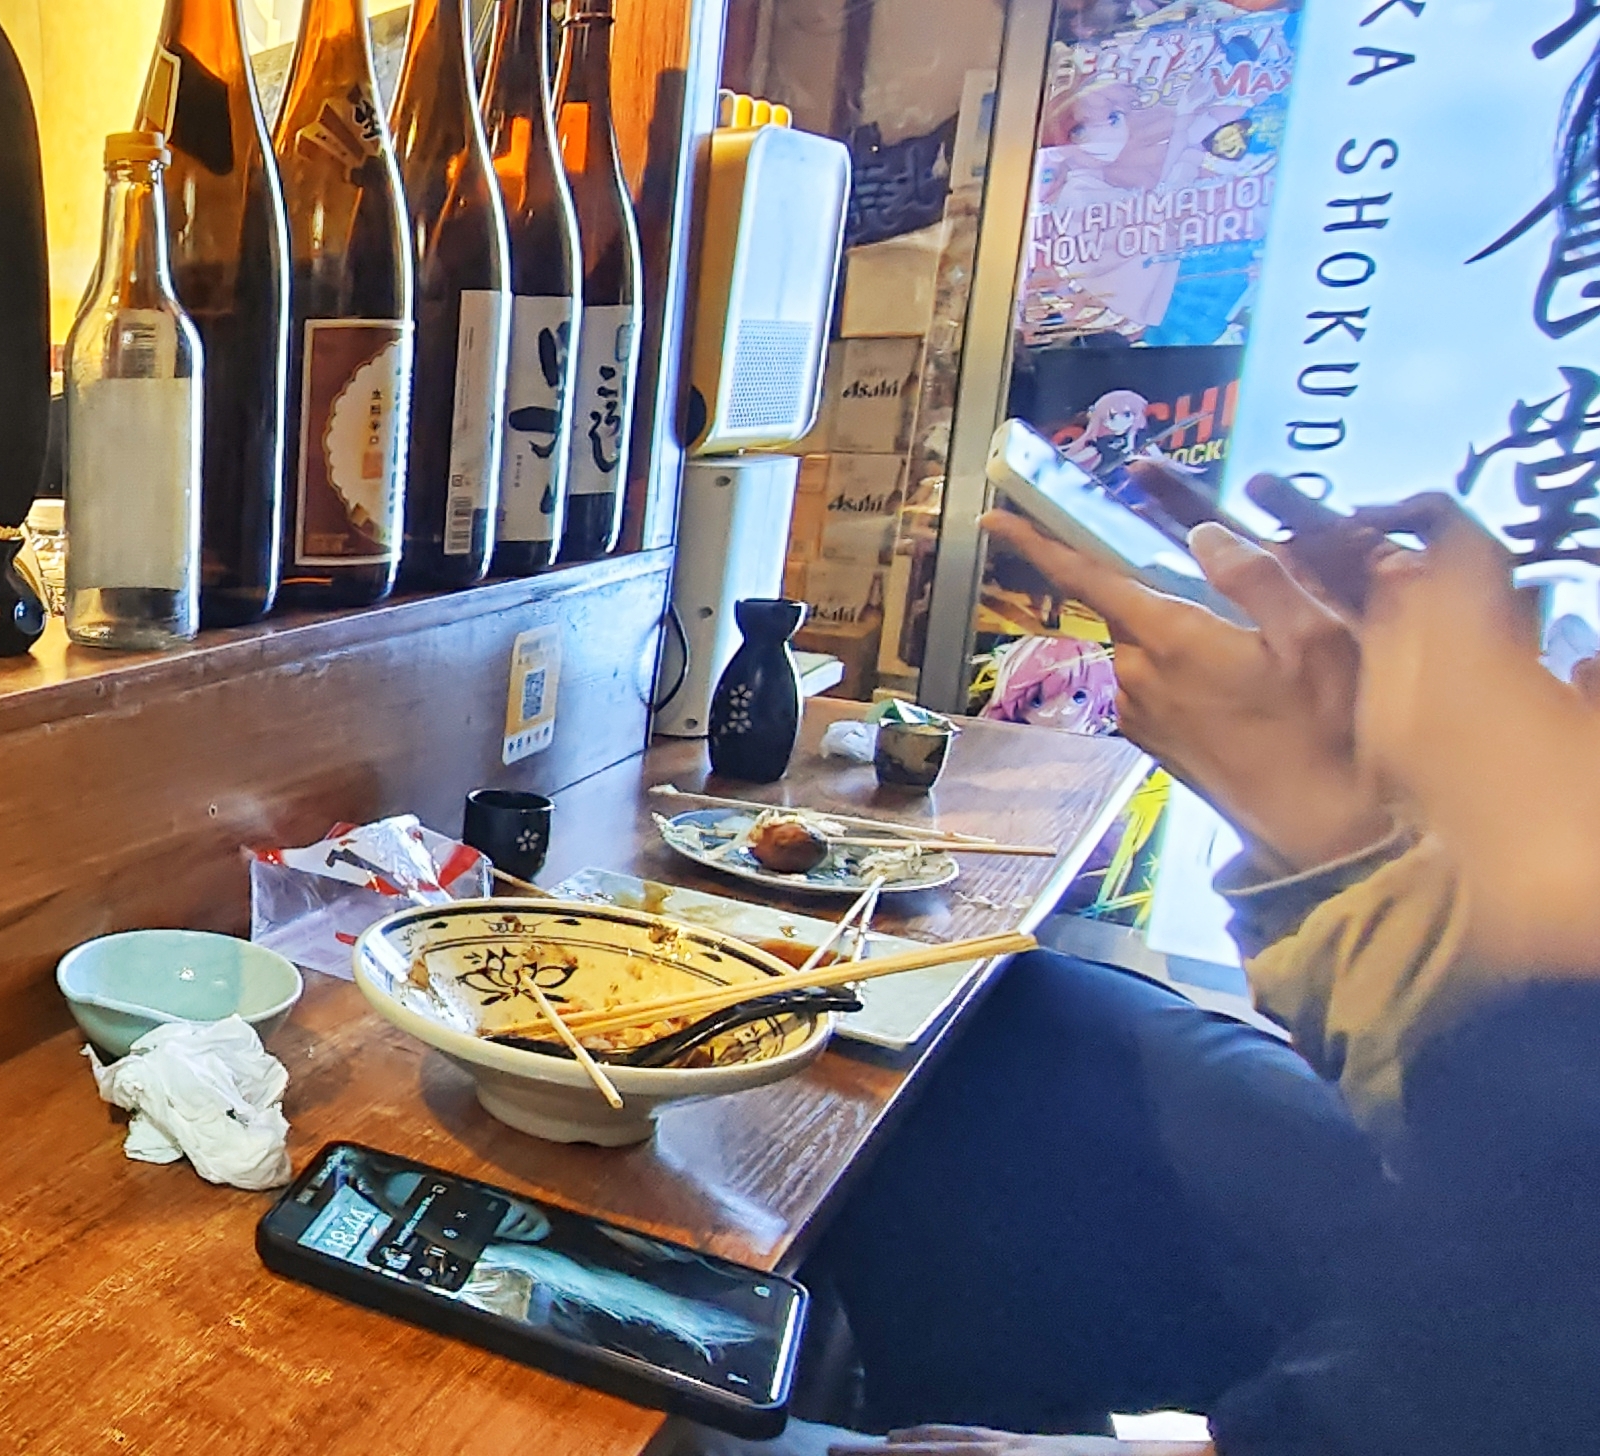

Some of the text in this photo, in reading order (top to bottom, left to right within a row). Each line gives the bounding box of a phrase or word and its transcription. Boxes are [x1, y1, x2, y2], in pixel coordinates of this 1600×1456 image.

[1028, 231, 1104, 269] NOW
[1117, 220, 1167, 257] ON
[1178, 210, 1255, 247] AIR!
[1030, 207, 1073, 240] TV
[325, 1207, 375, 1250] 18:44
